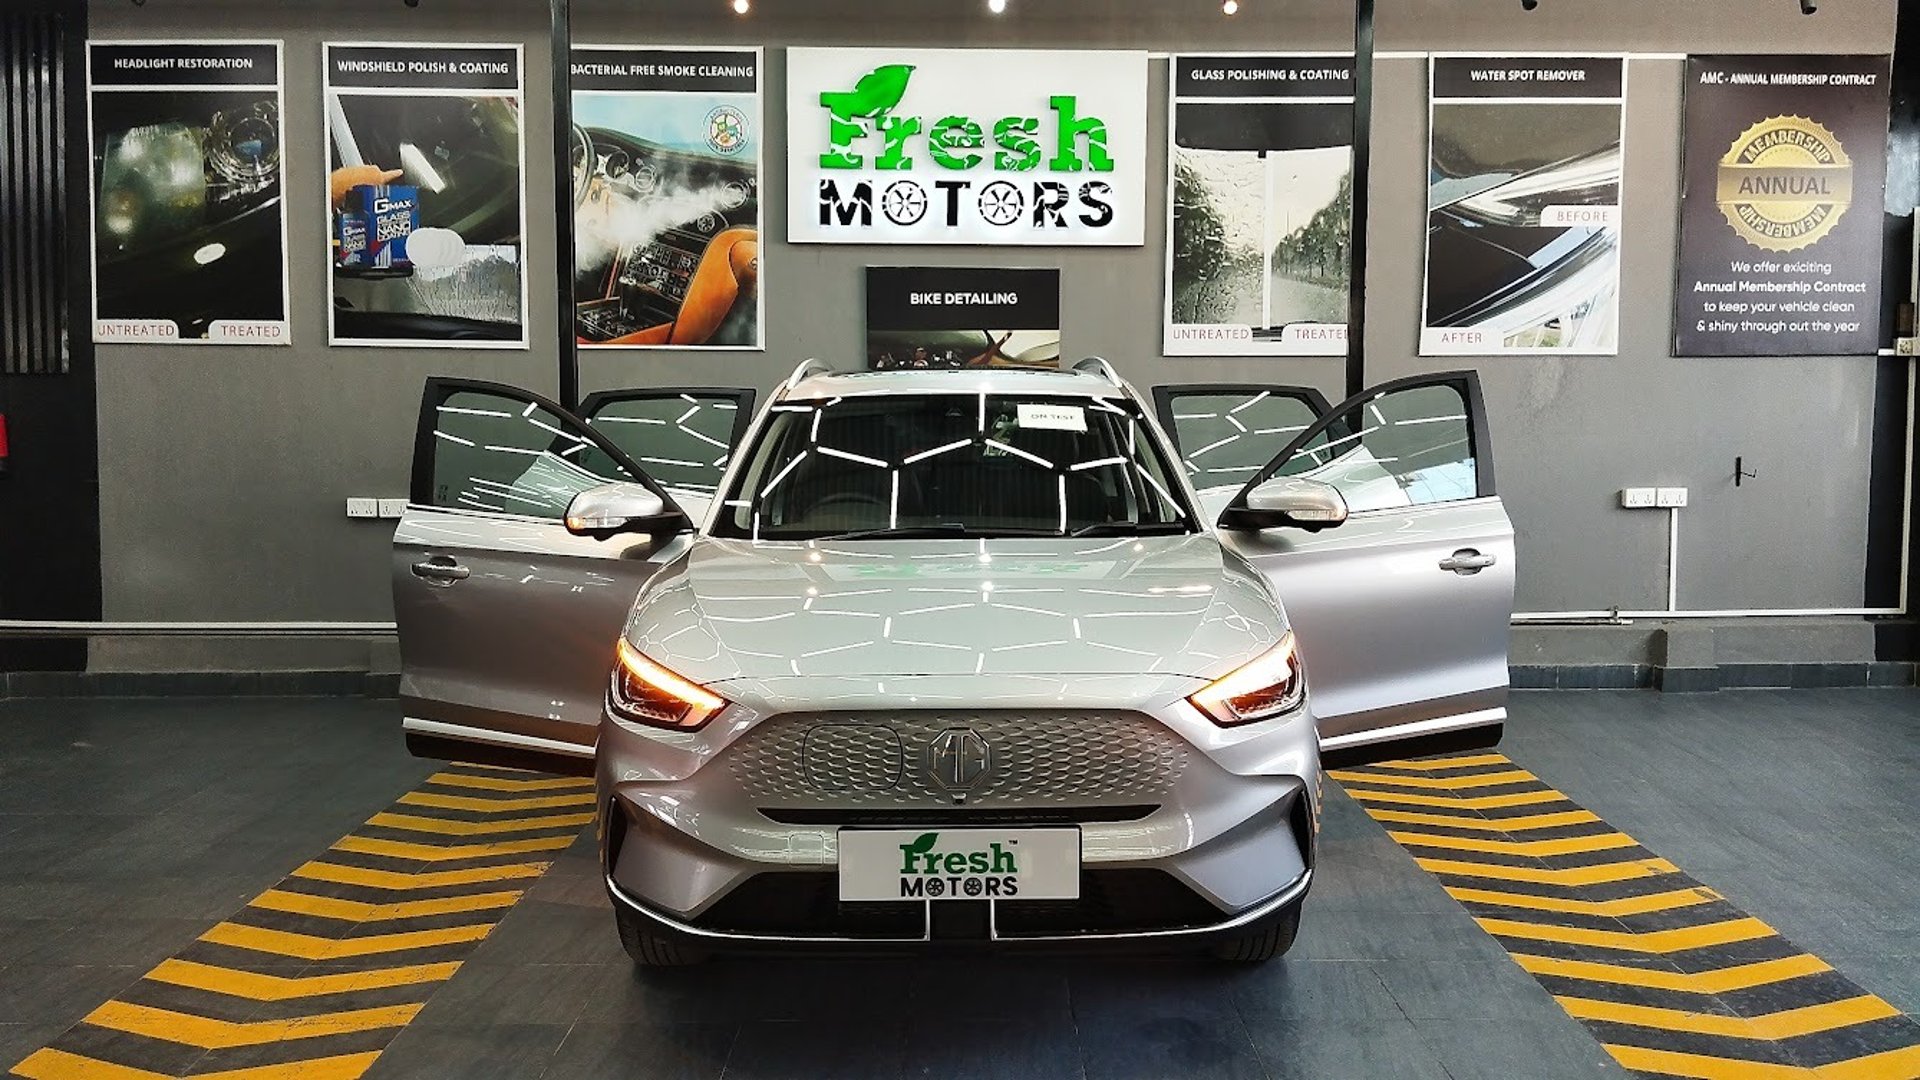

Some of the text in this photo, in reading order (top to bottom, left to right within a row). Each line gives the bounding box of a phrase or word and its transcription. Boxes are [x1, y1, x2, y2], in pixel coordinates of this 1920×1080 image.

[114, 58, 253, 69] HEADLIGHT RESTORATION
[337, 60, 509, 74] WINDSHIELD POLISH & COATING
[570, 64, 754, 77] BACTERIAL FREE SMOKE CLEANING
[1191, 69, 1350, 81] GLASS POLISHING & COATING
[1470, 70, 1586, 81] WATER SPOT REMOVER
[1700, 72, 1724, 84] AMC
[1730, 73, 1768, 85] ANNUAL
[1770, 74, 1828, 86] MEMBERSHIP
[1829, 74, 1877, 86] CONTRACT
[819, 64, 1115, 172] Fresh
[1743, 129, 1832, 163] MEMBERSHIP
[1738, 176, 1831, 195] ANNUAL
[819, 179, 1114, 228] MOTORS
[1557, 211, 1609, 222] BEFORE
[1738, 205, 1827, 238] MEMBERSHIP
[1731, 261, 1832, 275] We offer exiciting
[1693, 281, 1866, 294] Annual Membership Contract
[910, 293, 1018, 305] BIKE DETAILING
[1703, 301, 1855, 314] to keep your vehicle clean
[98, 325, 175, 337] UNTREATED
[221, 325, 281, 337] TREATED
[1696, 320, 1860, 334] & shiny through out the year
[1173, 329, 1250, 340] UNTREATED
[1441, 332, 1483, 344] AFTER
[931, 731, 987, 786] MG
[899, 832, 1018, 874] Fresh
[900, 876, 1018, 897] MOTORS
